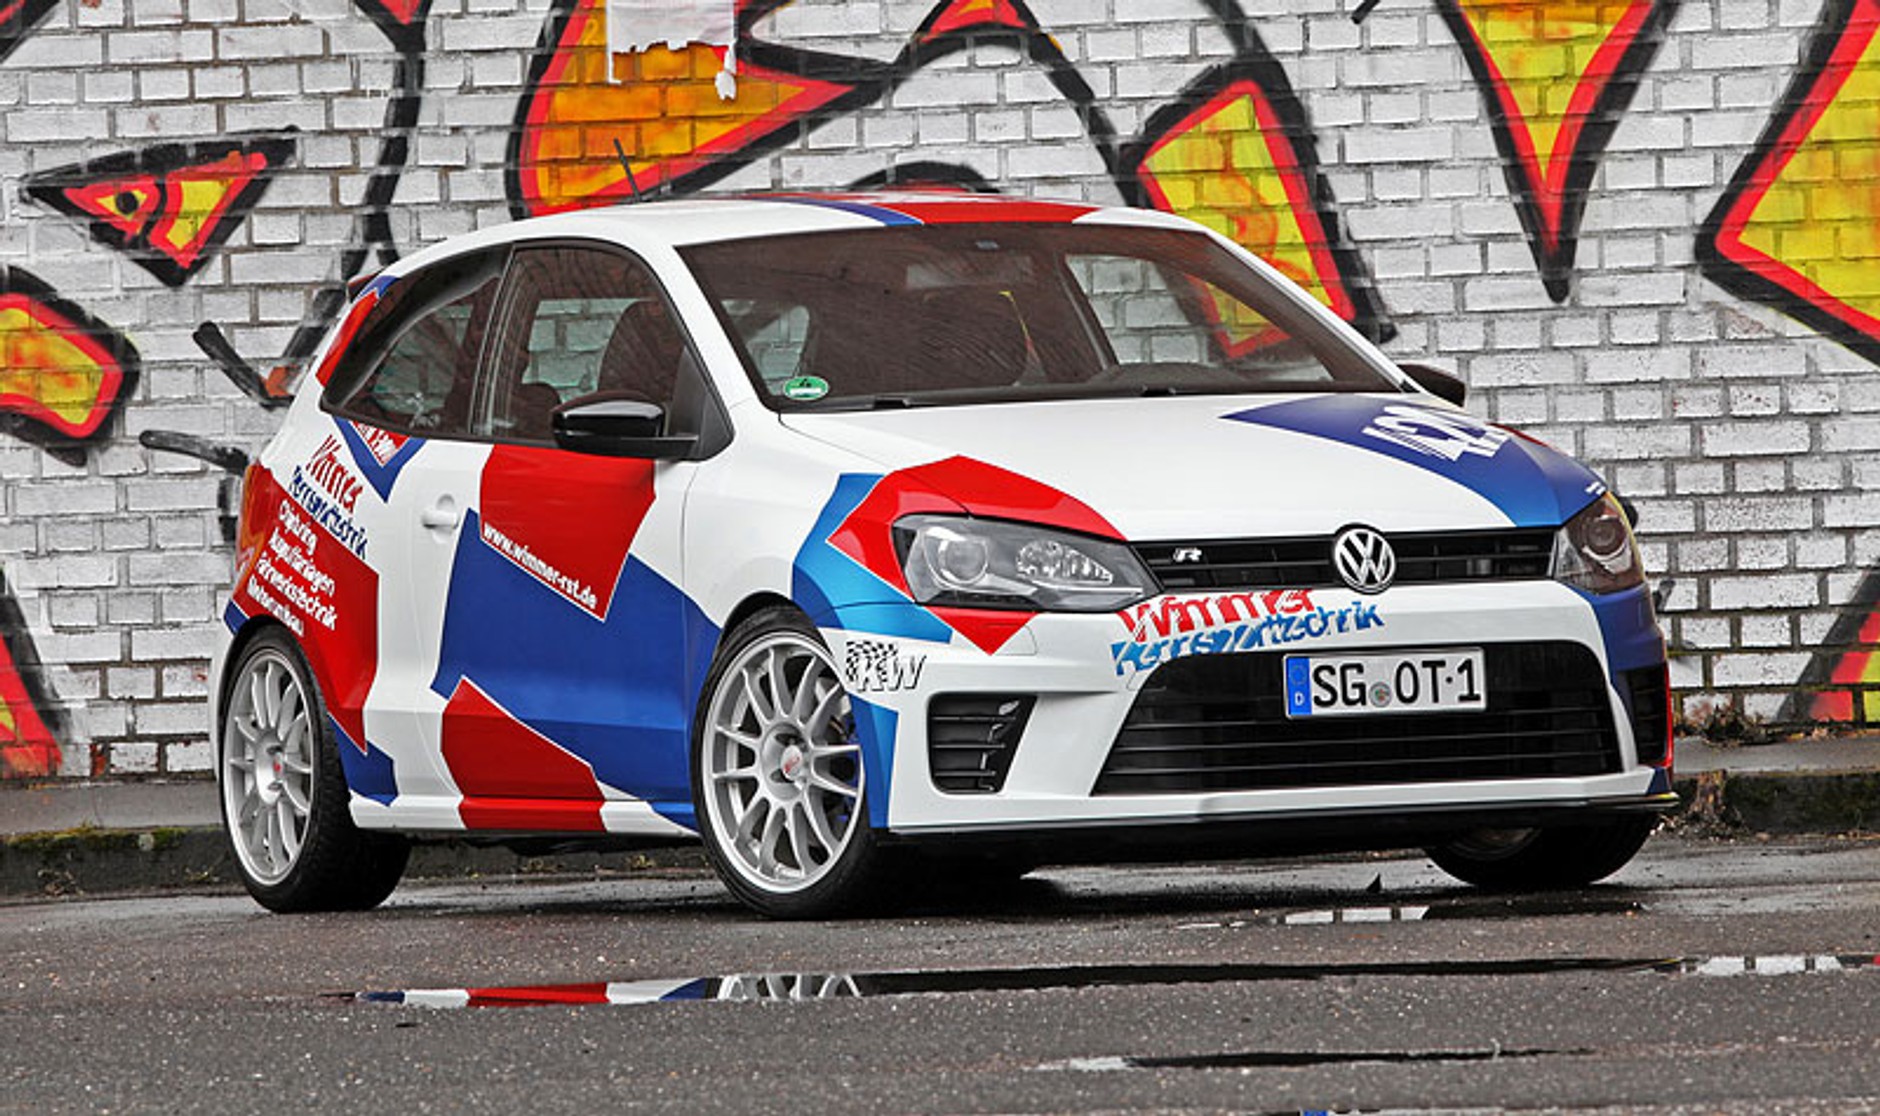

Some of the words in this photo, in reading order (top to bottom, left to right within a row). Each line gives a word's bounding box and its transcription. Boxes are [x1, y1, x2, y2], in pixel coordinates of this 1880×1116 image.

[484, 521, 597, 609] www.wimmer-rst.de
[1173, 547, 1202, 562] R
[1335, 528, 1395, 590] VW
[1312, 664, 1367, 708] SG
